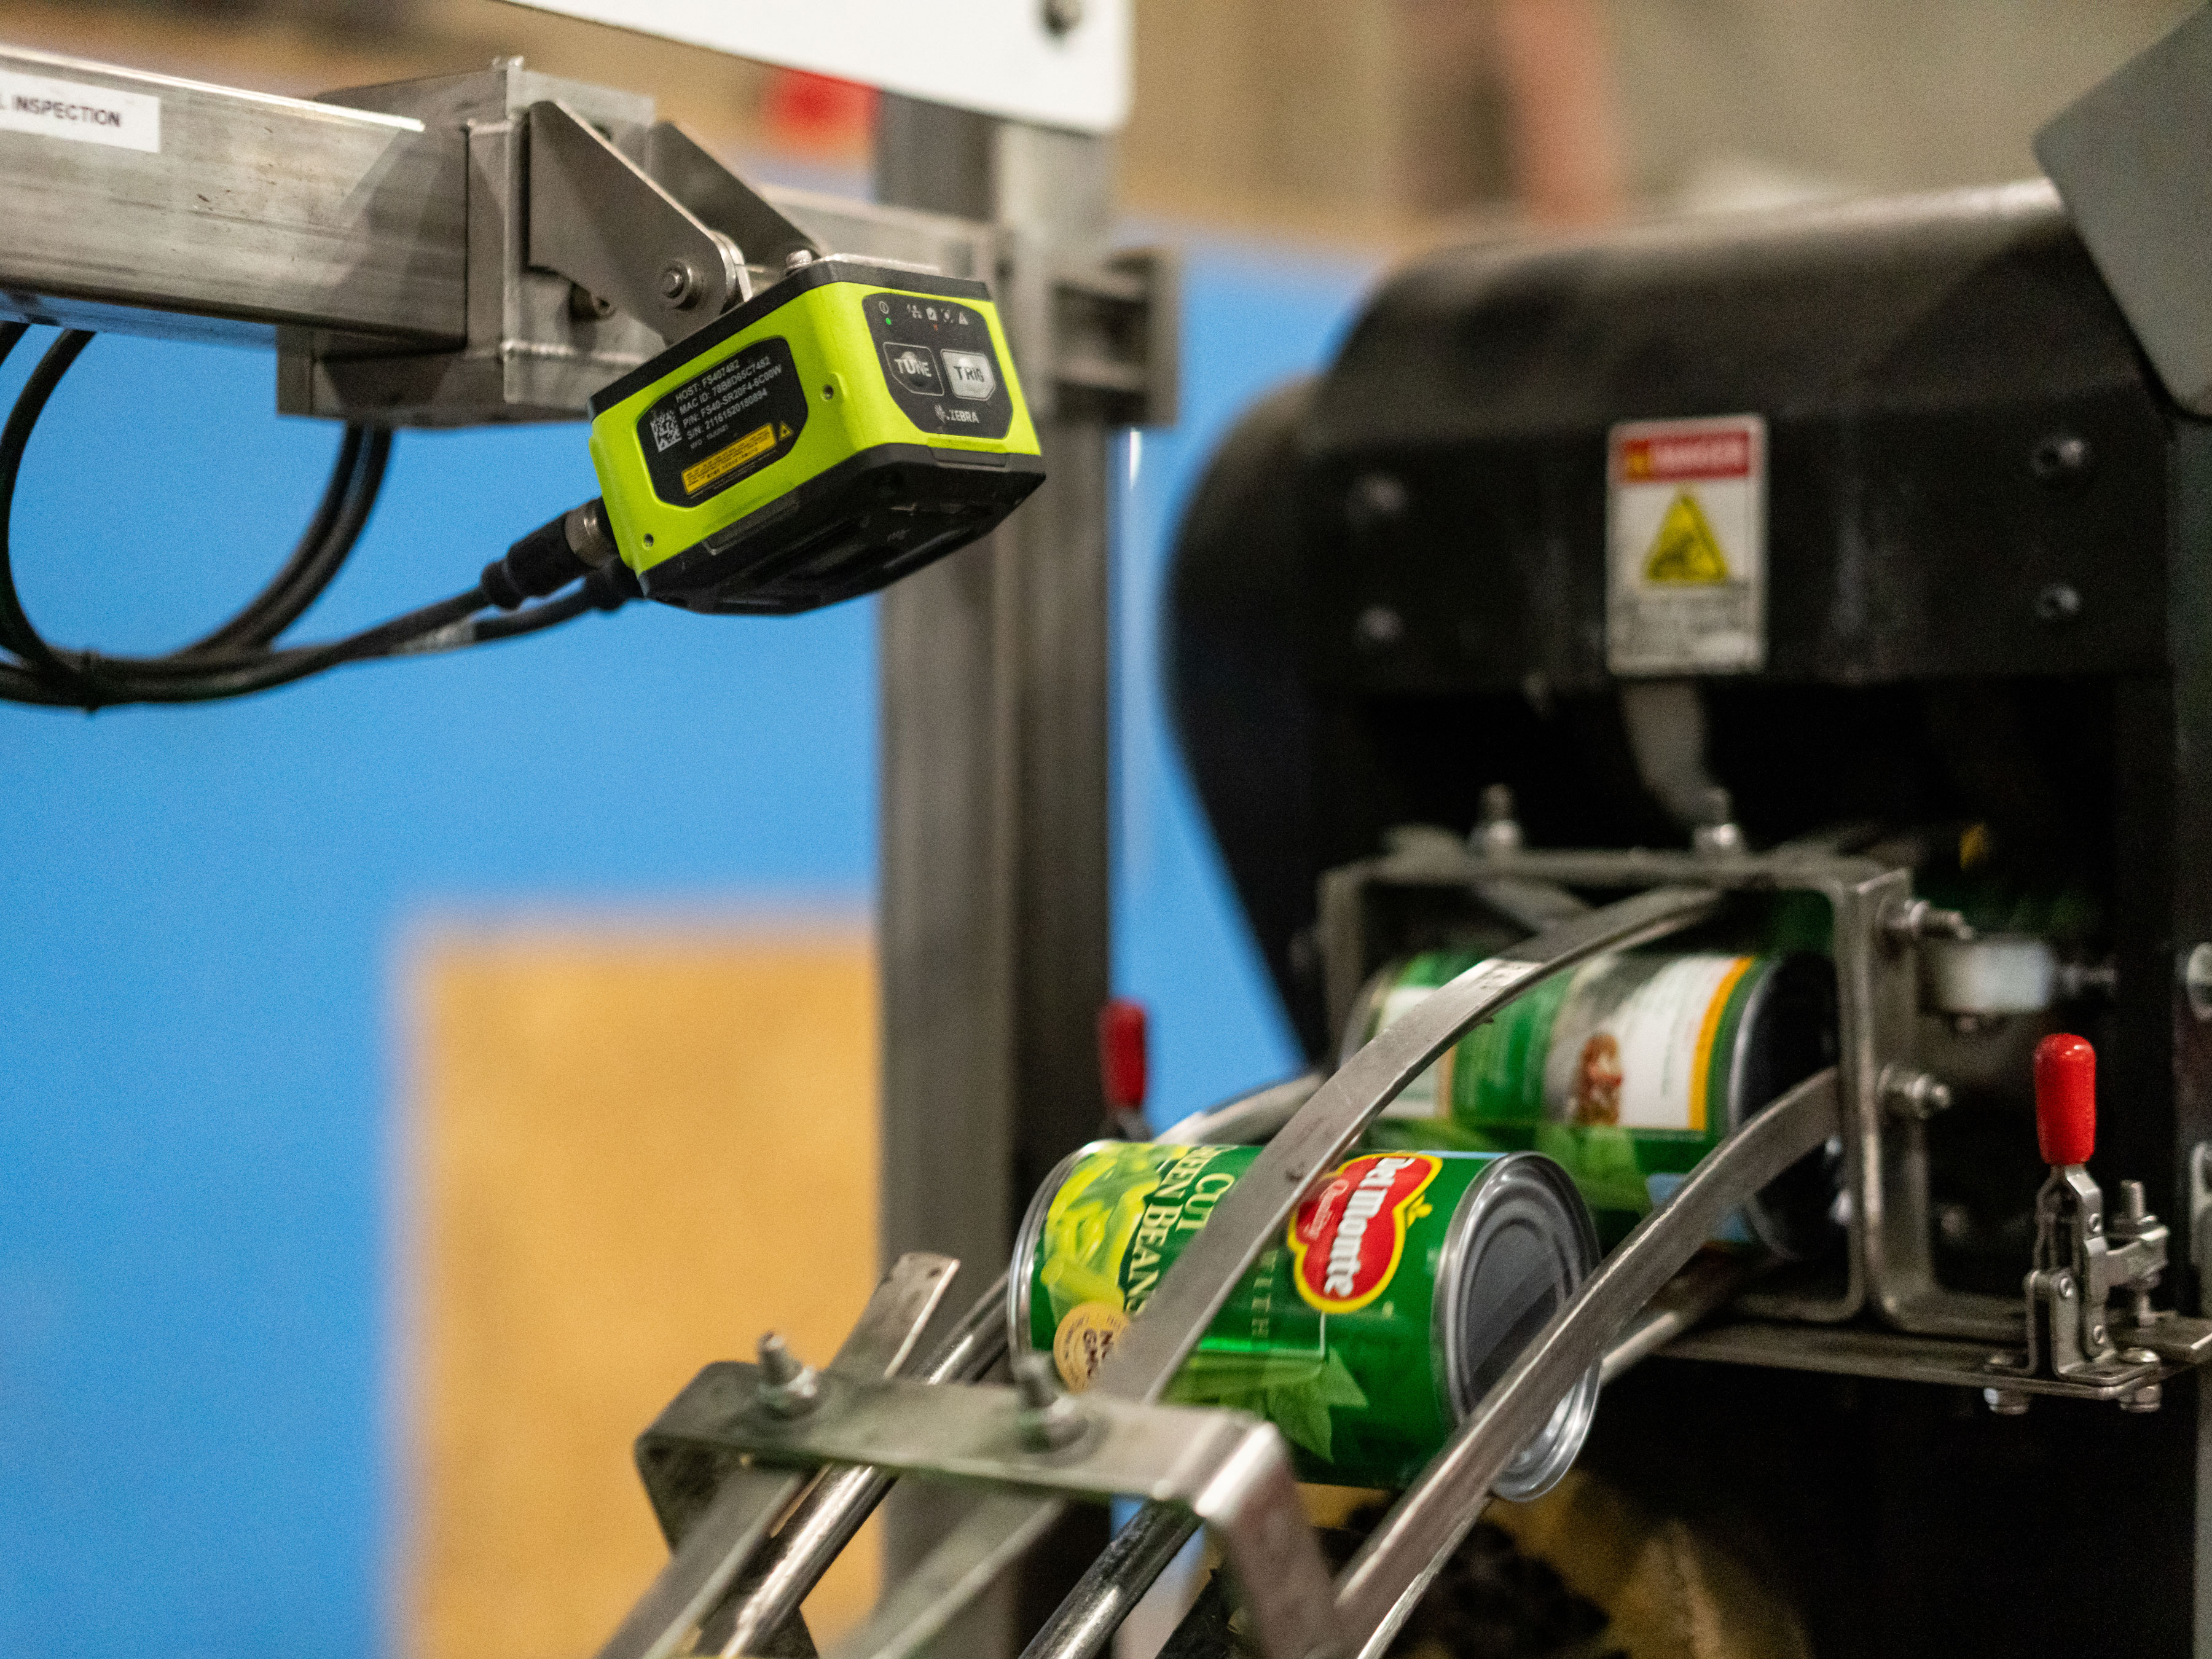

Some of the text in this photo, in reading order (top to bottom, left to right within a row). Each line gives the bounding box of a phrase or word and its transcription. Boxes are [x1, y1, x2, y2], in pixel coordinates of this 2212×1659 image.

[13, 96, 121, 127] INSPECTION
[894, 358, 931, 377] TUNE
[954, 366, 984, 382] TRIG
[676, 383, 700, 402] HOST:
[679, 398, 698, 415] MAC
[950, 409, 979, 423] ZEBRA
[1175, 1173, 1235, 1231] CUT
[1324, 1188, 1387, 1296] Monte
